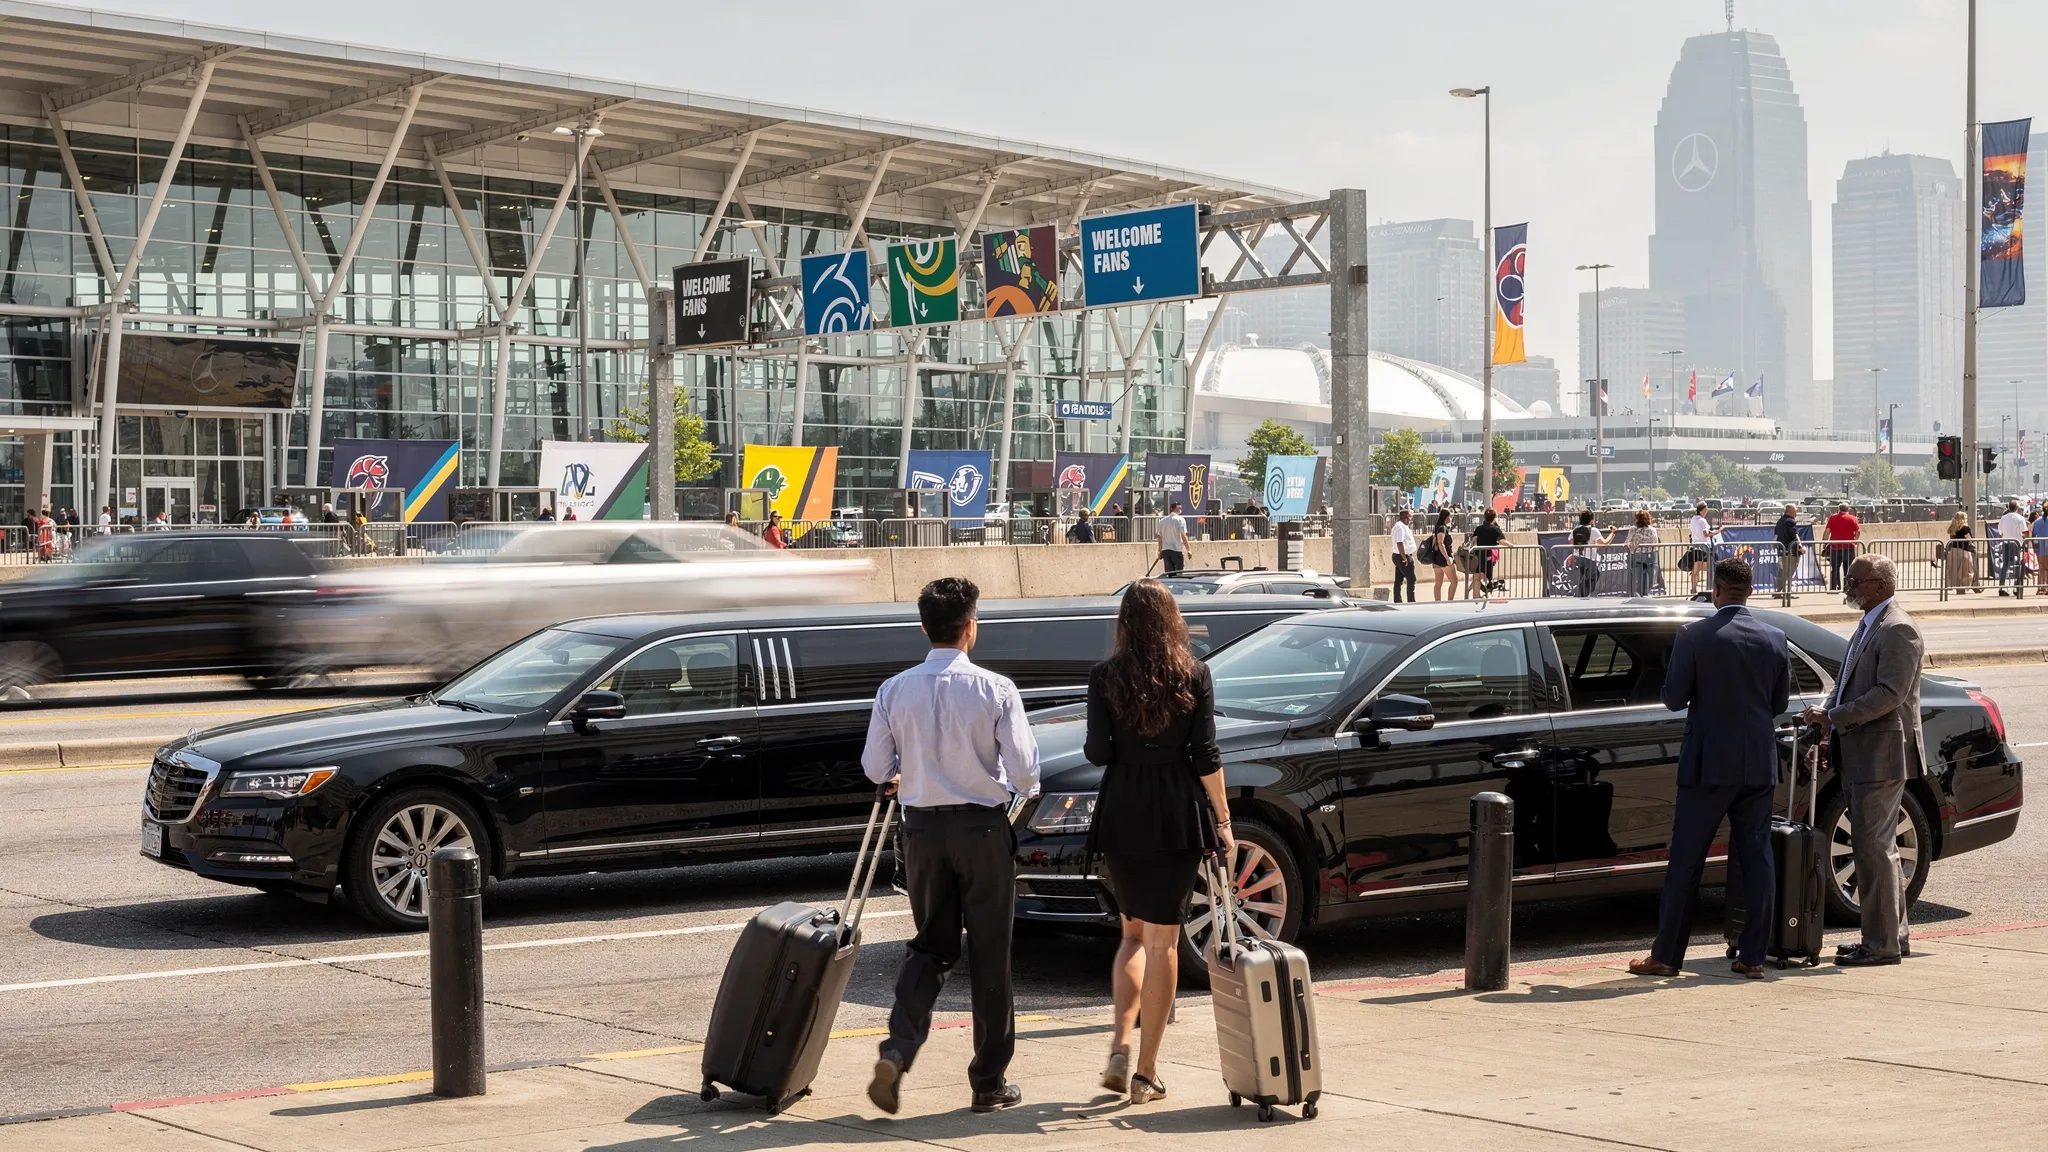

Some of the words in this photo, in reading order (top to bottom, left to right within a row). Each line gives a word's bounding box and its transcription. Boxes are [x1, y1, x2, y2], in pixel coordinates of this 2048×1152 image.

[1091, 222, 1162, 251] WELCOME
[1093, 250, 1131, 274] FANS
[682, 274, 731, 297] WELCOME
[682, 297, 708, 317] FANS
